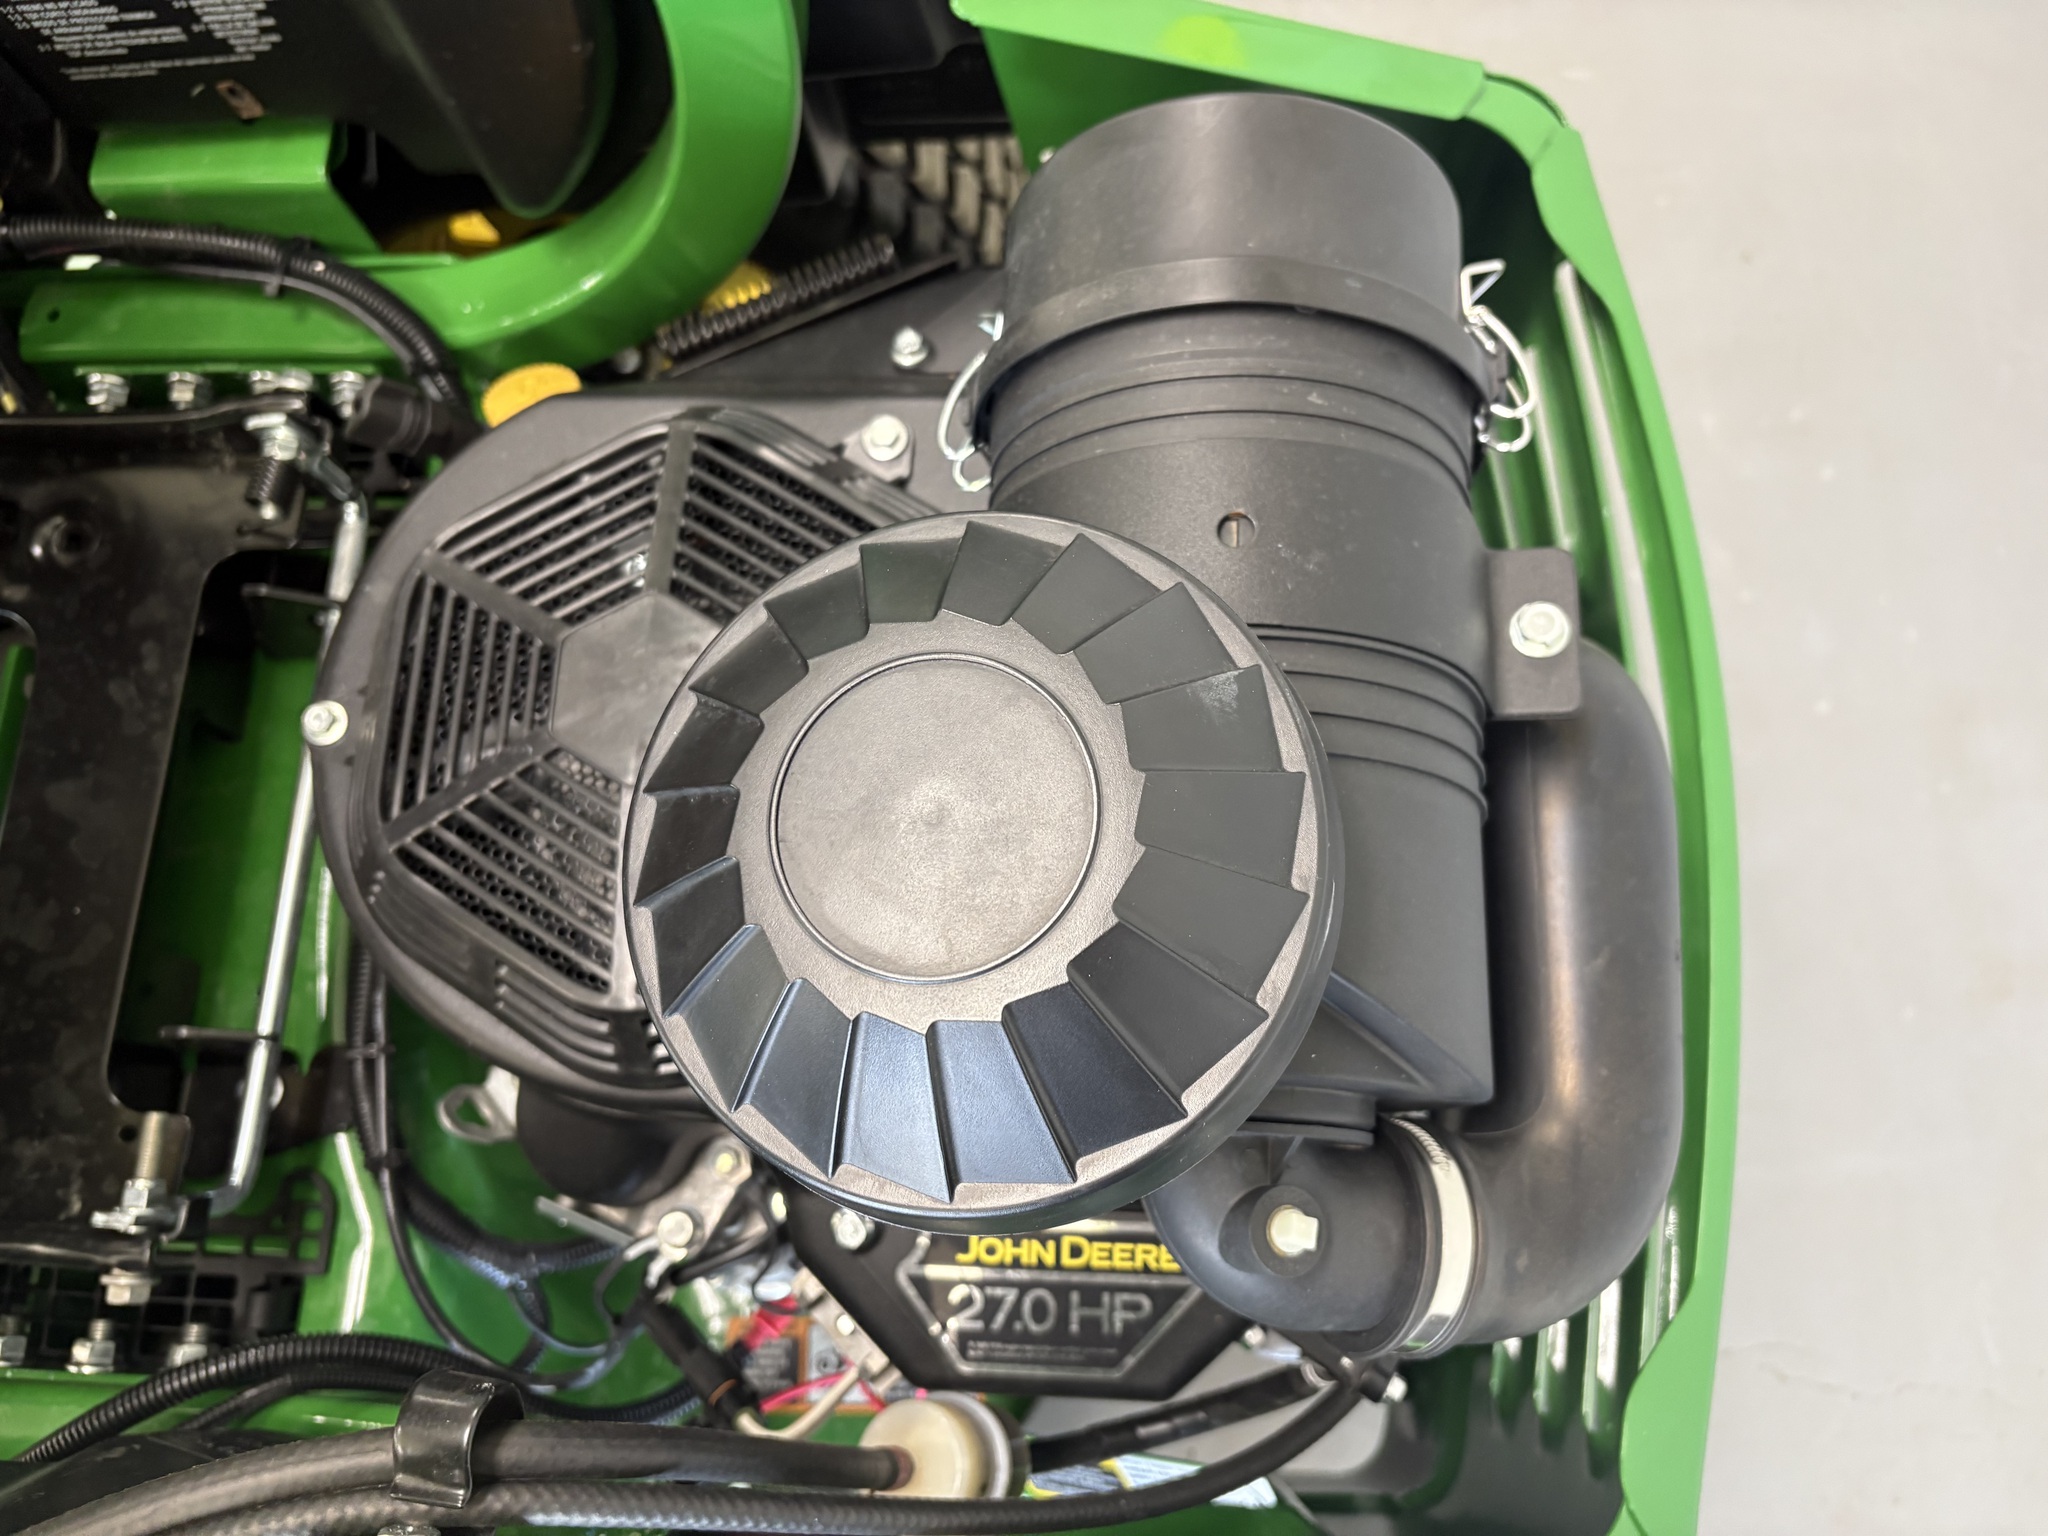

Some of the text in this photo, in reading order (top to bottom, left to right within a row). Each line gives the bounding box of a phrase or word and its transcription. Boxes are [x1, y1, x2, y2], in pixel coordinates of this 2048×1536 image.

[956, 1235, 1057, 1268] JOHN
[947, 1283, 1153, 1336] 27.0 HP
